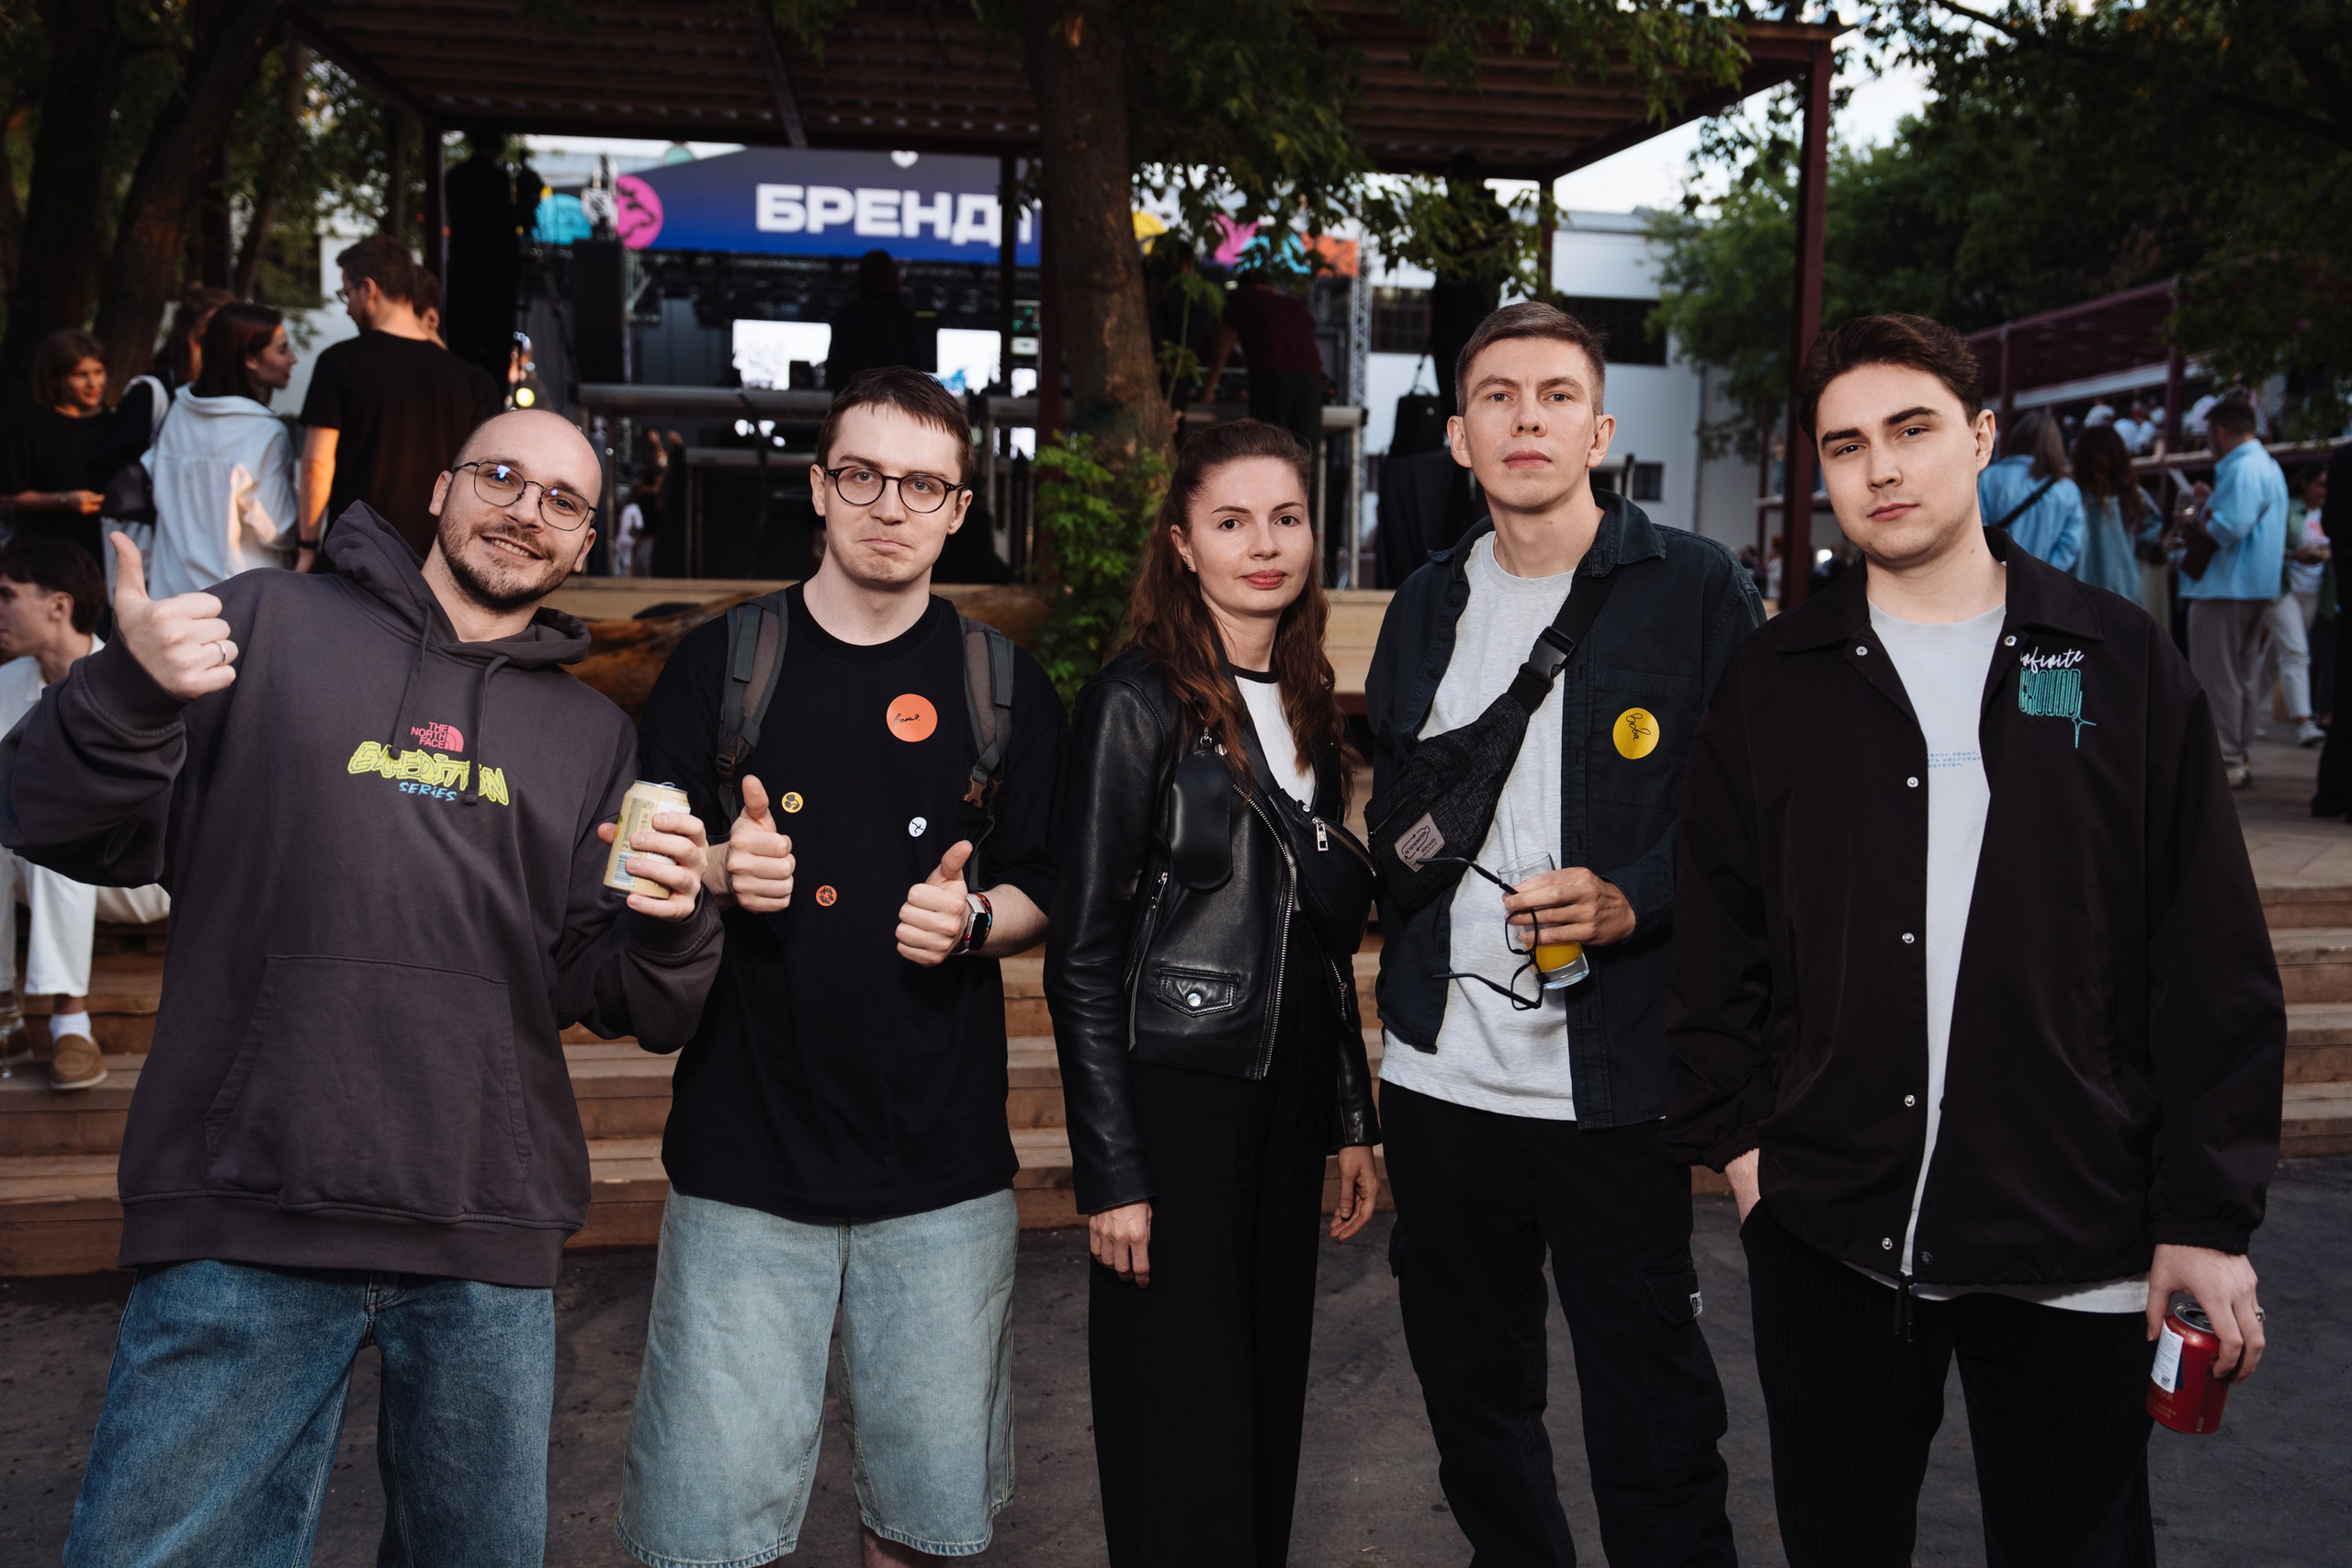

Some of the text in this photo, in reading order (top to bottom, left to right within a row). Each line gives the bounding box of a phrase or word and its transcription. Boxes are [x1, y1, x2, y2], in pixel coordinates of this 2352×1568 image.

[411, 726, 447, 741] NORTH
[428, 721, 448, 733] THE
[419, 736, 445, 750] FACE
